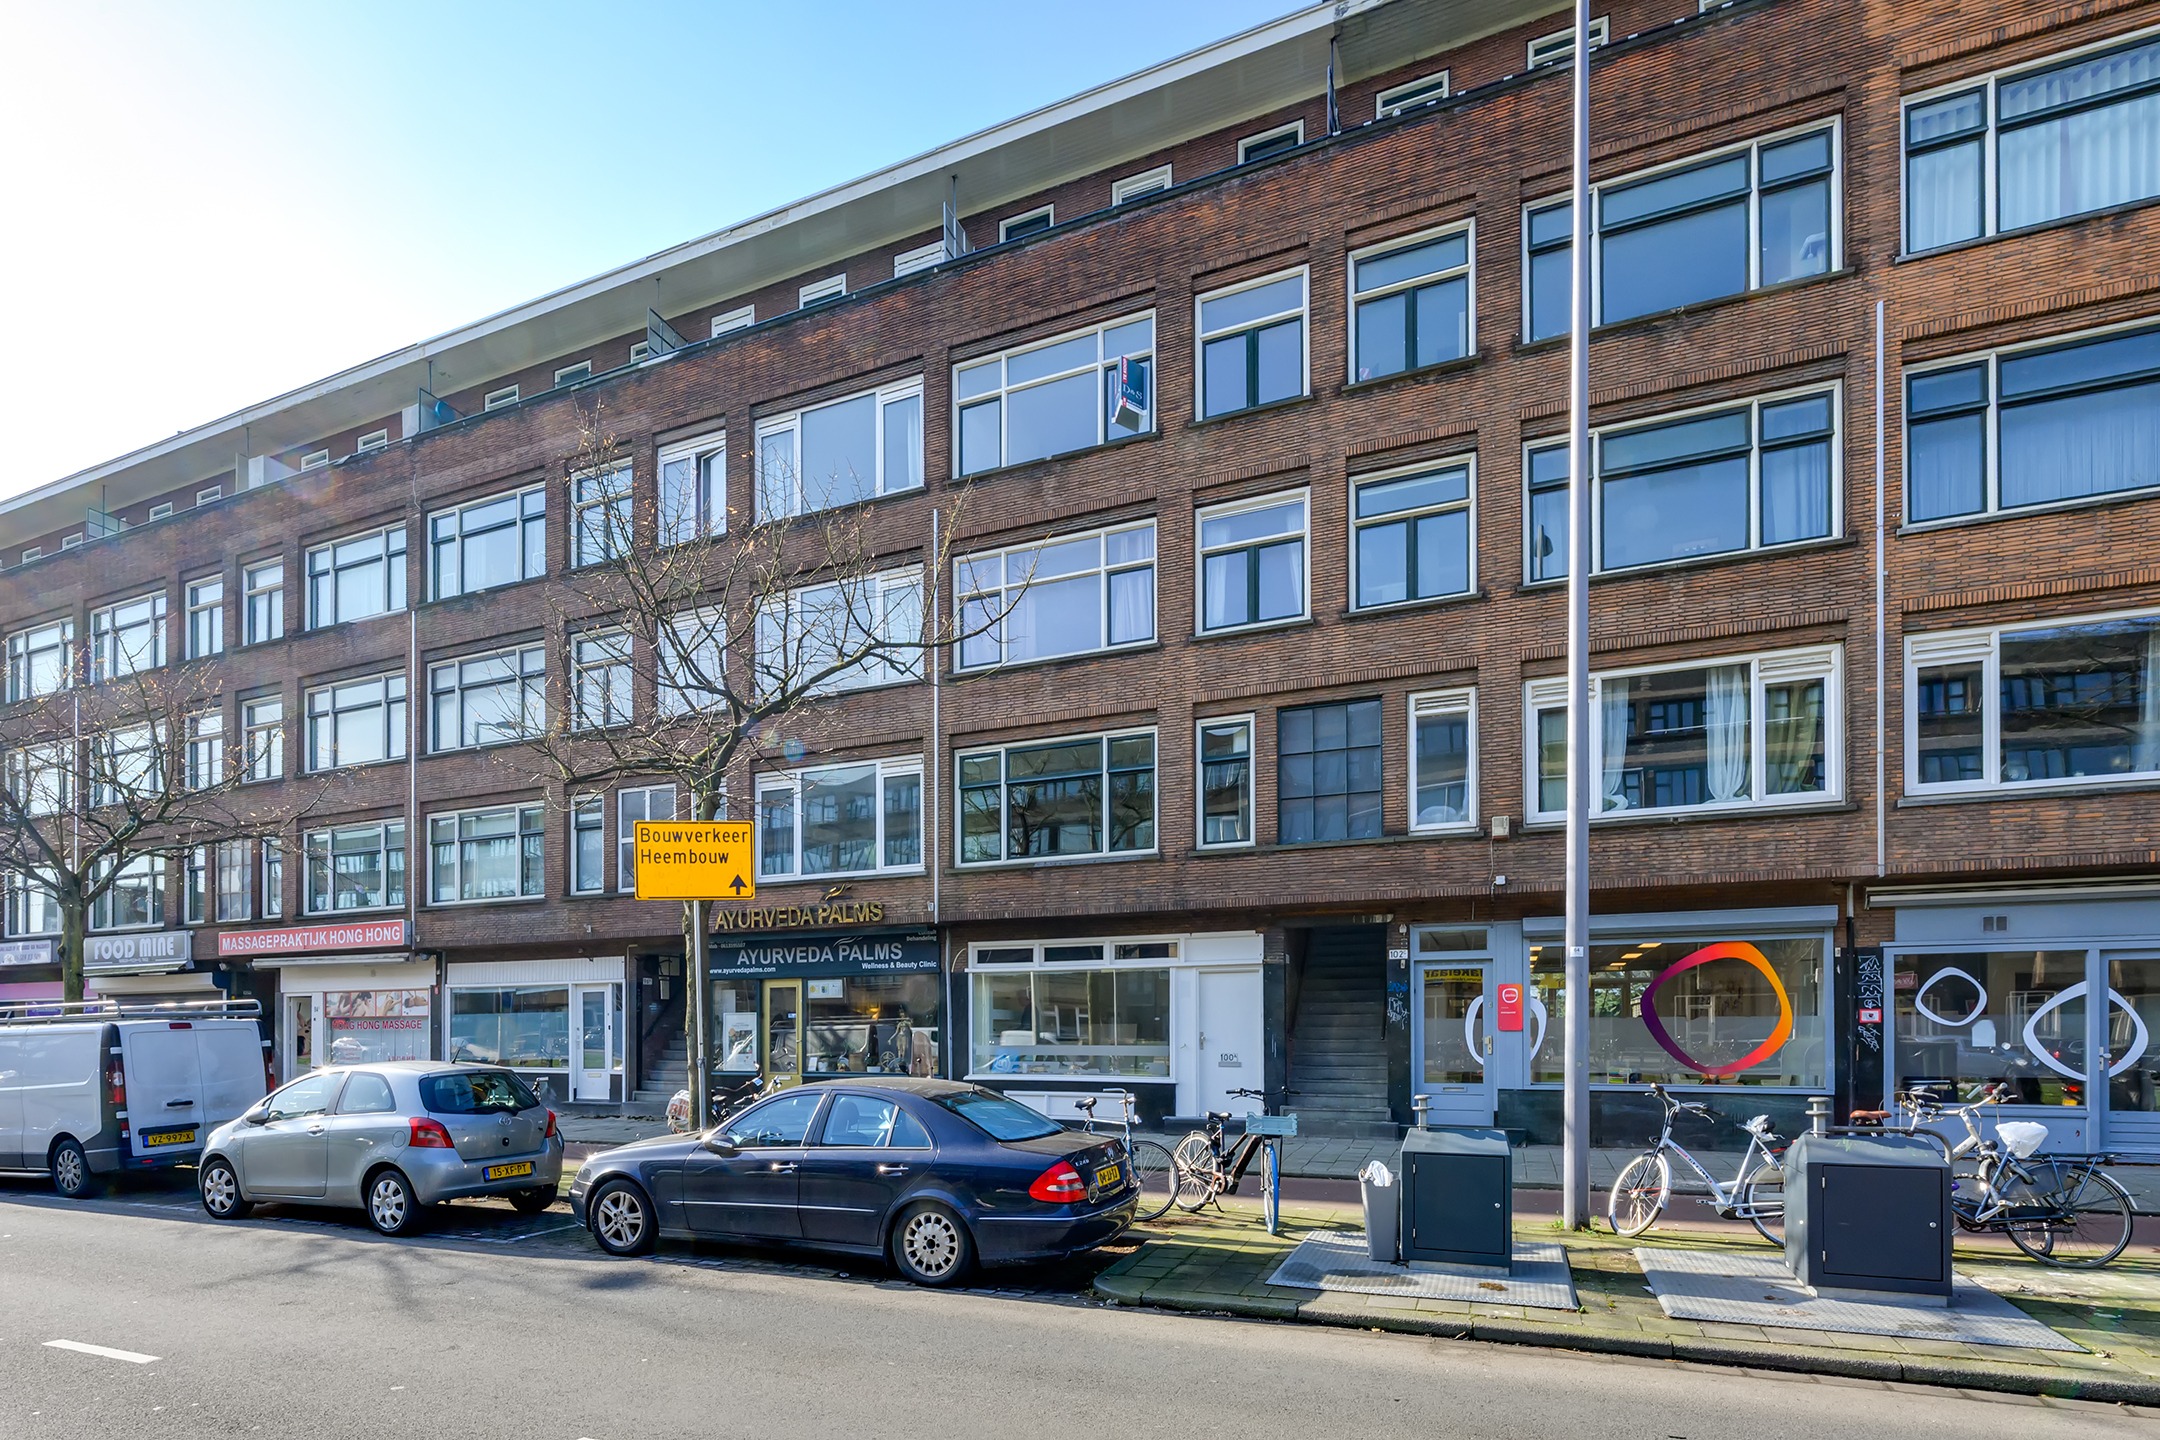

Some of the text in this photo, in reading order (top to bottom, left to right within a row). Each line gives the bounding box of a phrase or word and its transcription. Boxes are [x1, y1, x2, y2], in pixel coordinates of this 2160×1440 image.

[640, 827, 748, 843] Bouwverkeer
[641, 849, 729, 864] Heembouw
[715, 901, 885, 930] AYURVEDA PALMS
[222, 926, 401, 951] MASSAGEPRAKTIJK HONG HONG
[94, 939, 135, 960] FOOD
[737, 943, 903, 965] AYURVEDA PALMS
[709, 966, 776, 975] www.ayurvedapalms.com
[896, 961, 918, 970] Beauty
[918, 960, 937, 968] Clinic
[357, 1020, 380, 1030] HONG
[382, 1020, 422, 1029] MASSAGE
[152, 1133, 191, 1144] VZ-997-X
[493, 1164, 527, 1178] 15-XF-PT
